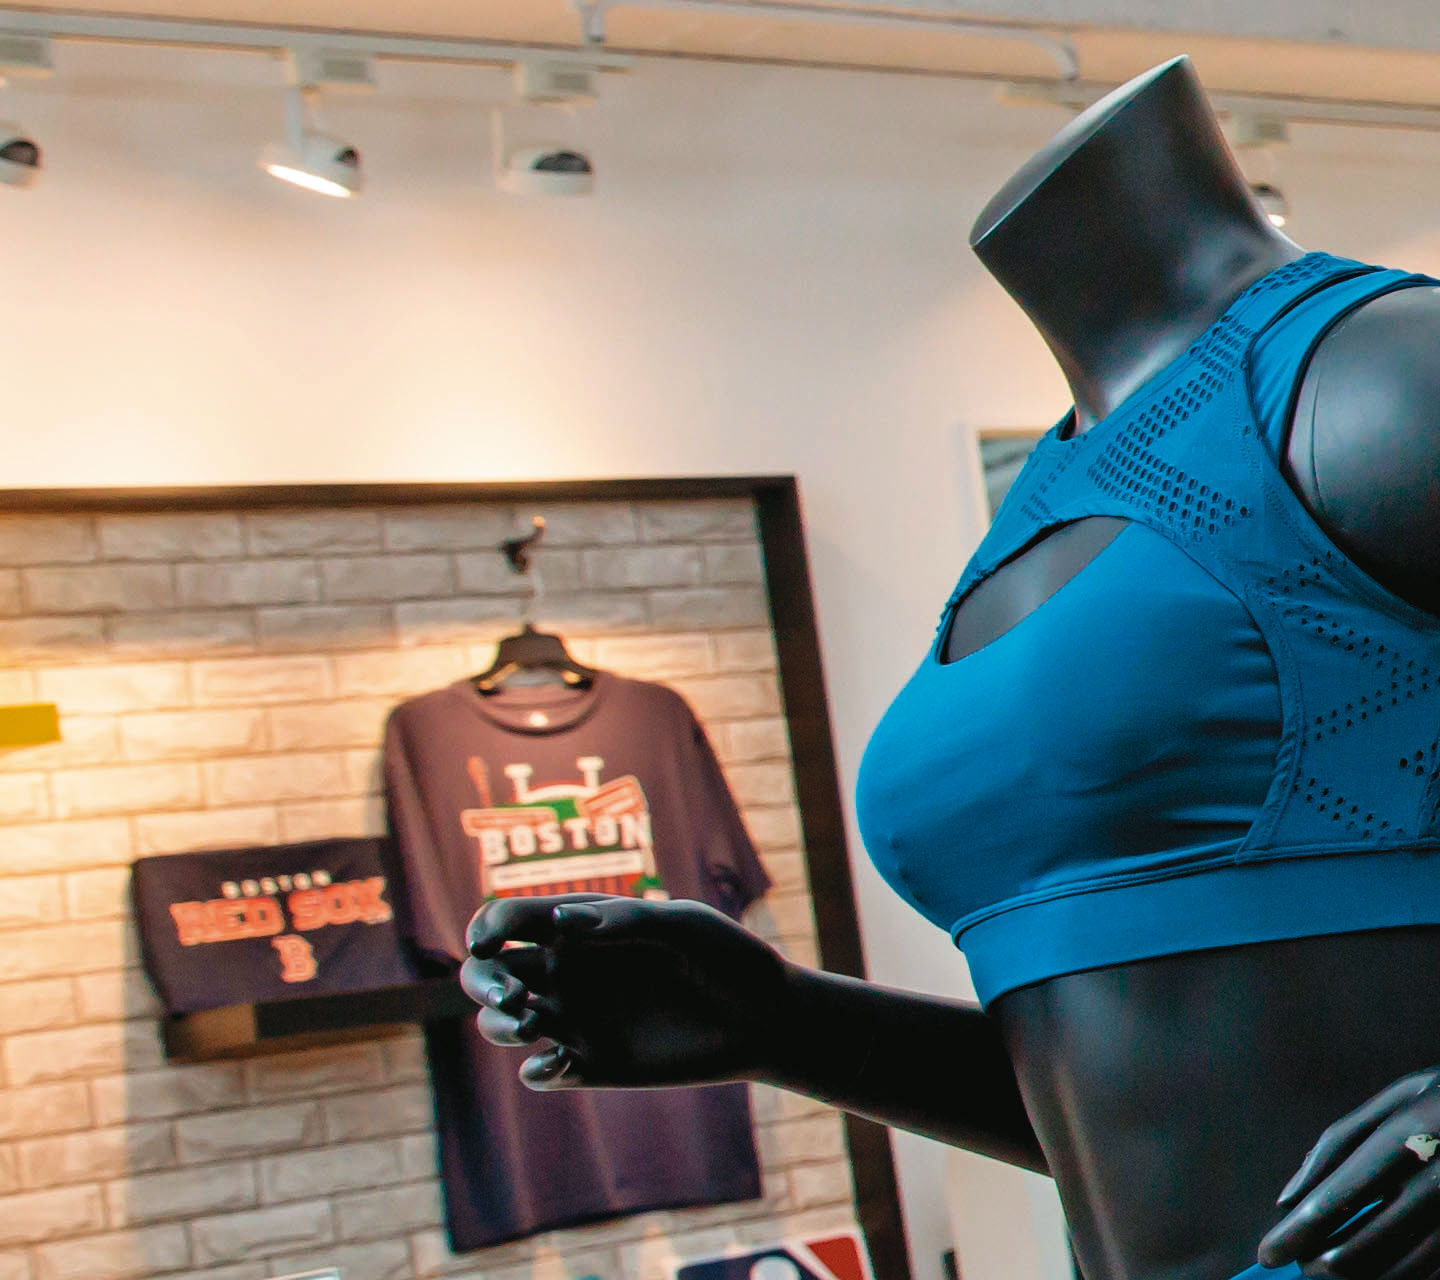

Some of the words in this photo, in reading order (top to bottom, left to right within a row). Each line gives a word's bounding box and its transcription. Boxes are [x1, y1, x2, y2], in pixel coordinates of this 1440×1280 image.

[479, 811, 651, 865] BOSTON
[169, 896, 285, 946] RED
[287, 876, 393, 931] SOX
